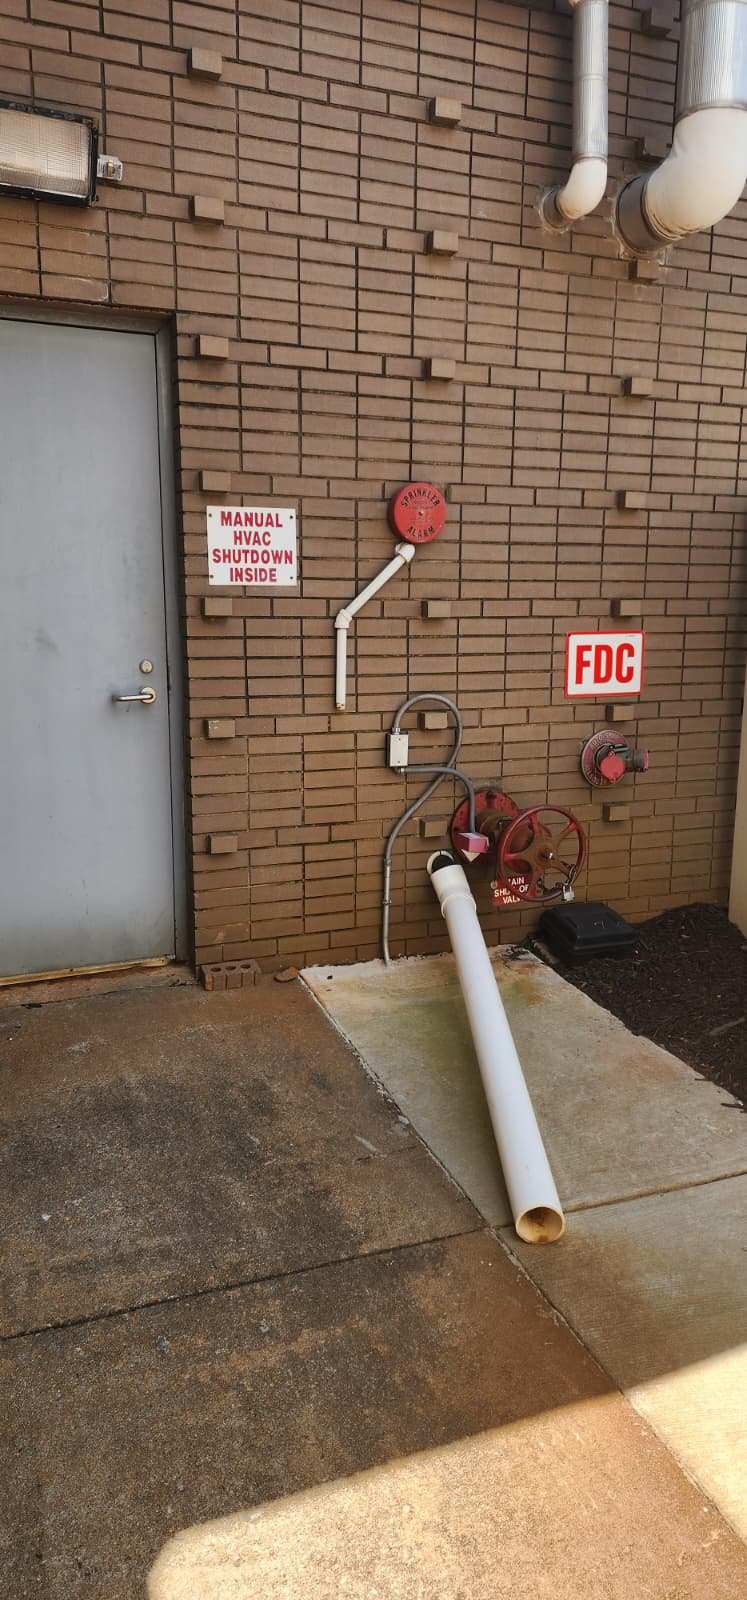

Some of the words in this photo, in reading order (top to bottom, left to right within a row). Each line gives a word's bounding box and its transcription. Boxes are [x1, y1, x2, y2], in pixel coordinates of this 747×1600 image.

[401, 488, 440, 507] SPRINKLER
[220, 511, 283, 528] MANUAL
[233, 530, 271, 546] HVAC
[408, 526, 435, 537] ALARM
[212, 548, 293, 564] SHUTDOWN
[229, 567, 277, 582] INSIDE
[575, 643, 635, 684] FDC
[502, 895, 521, 904] VAL
